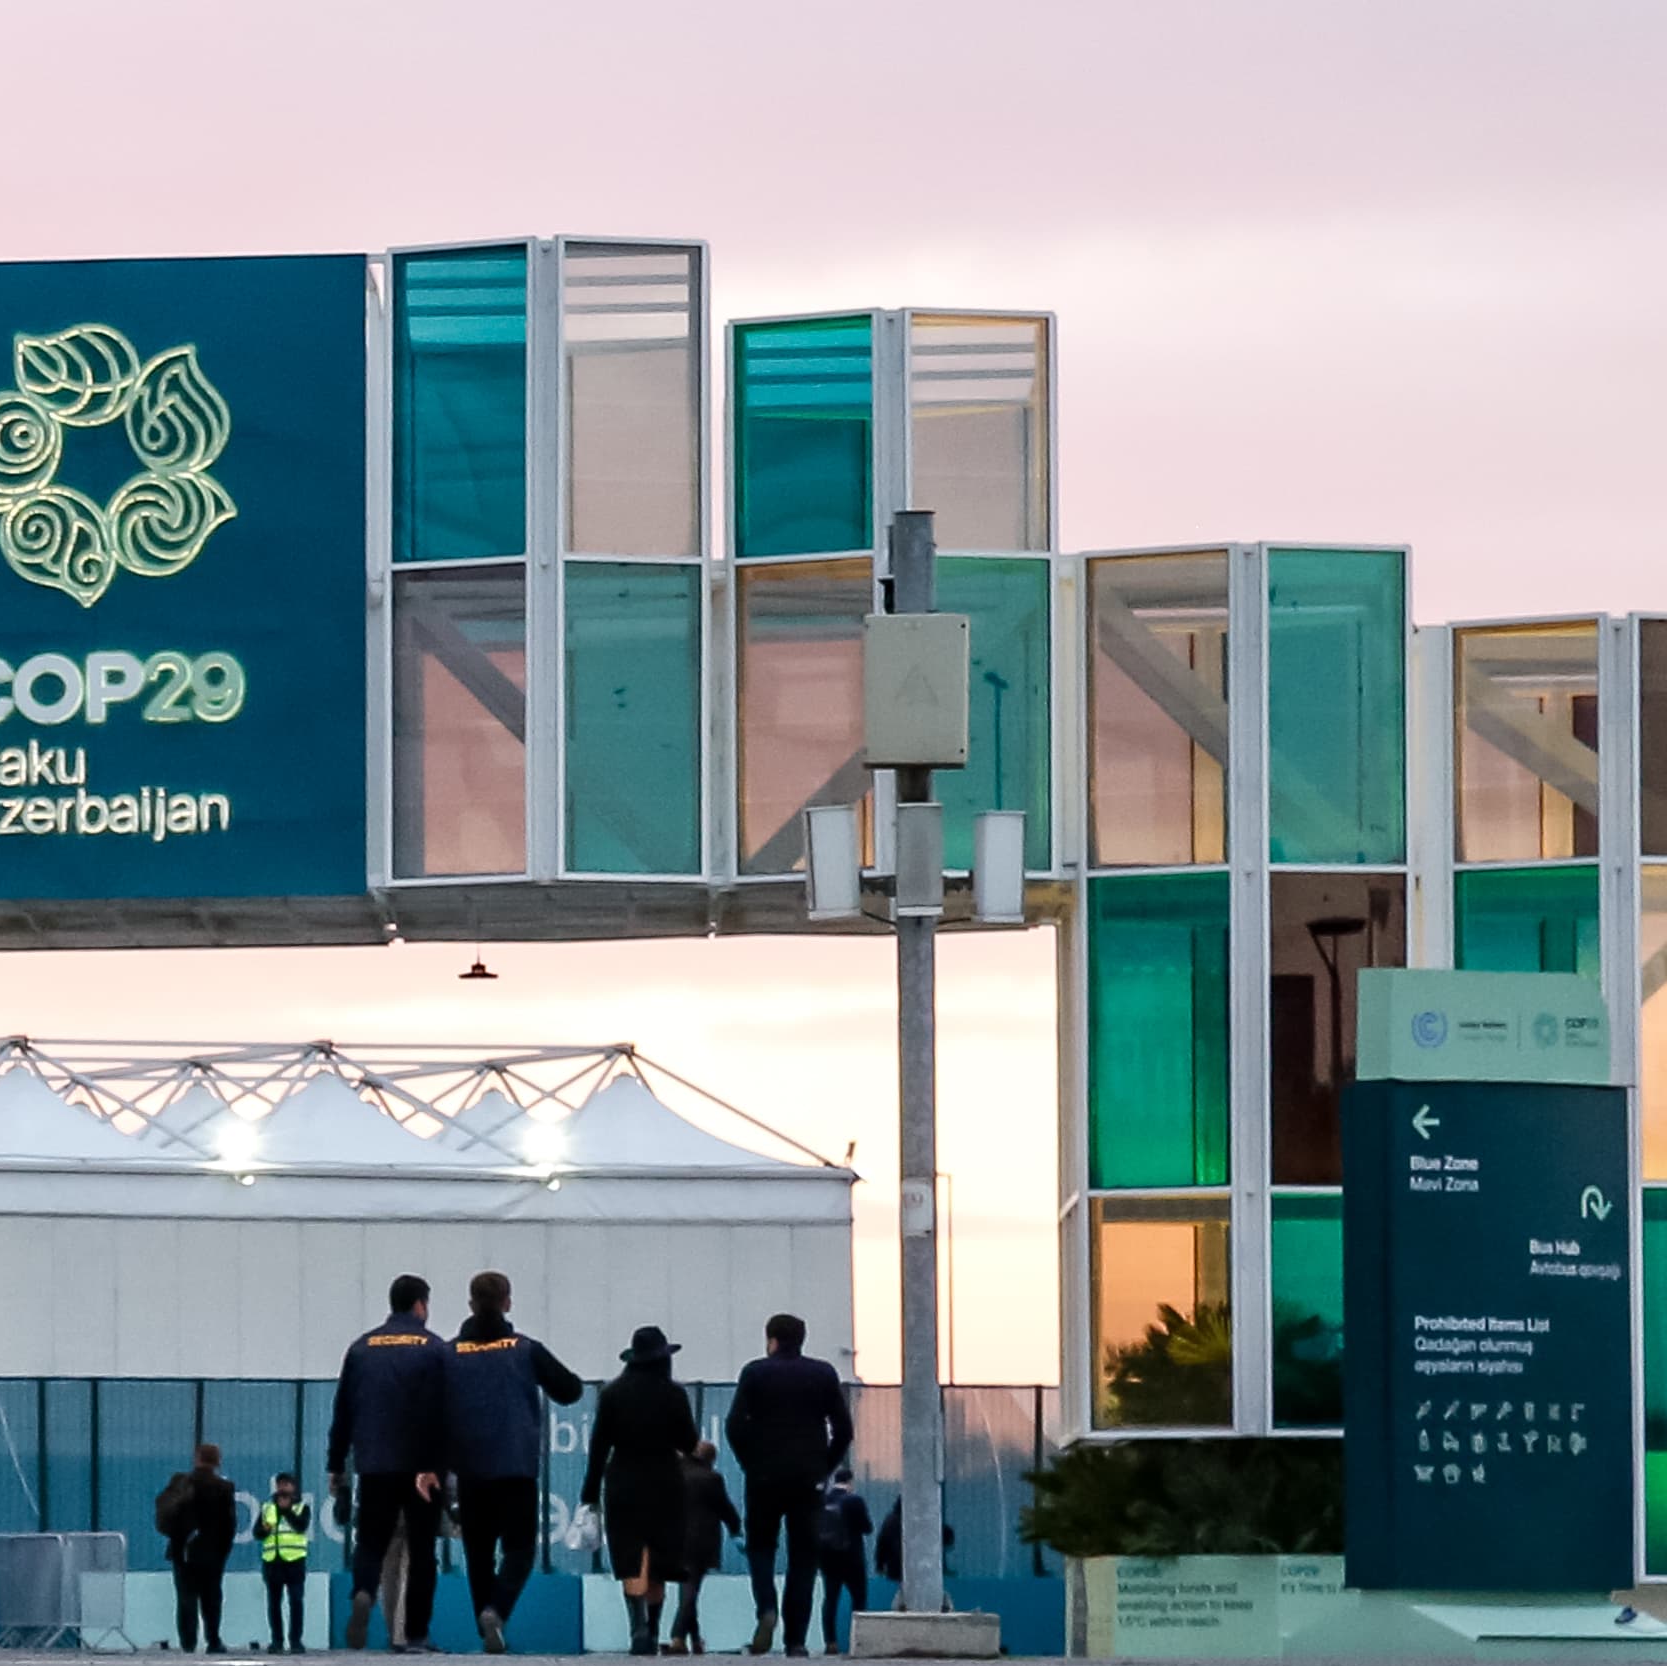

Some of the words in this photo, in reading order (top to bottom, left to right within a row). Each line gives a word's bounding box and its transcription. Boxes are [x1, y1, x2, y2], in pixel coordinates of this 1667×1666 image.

[1409, 1155, 1441, 1171] Blue
[1444, 1155, 1479, 1172] Zone
[1445, 1175, 1479, 1191] Zona
[1529, 1239, 1553, 1255] Bus
[1555, 1240, 1580, 1256] Hub
[1414, 1315, 1486, 1332] Prohibited
[1488, 1316, 1525, 1332] Items
[1527, 1317, 1550, 1333] List
[367, 1334, 428, 1347] SECURITY
